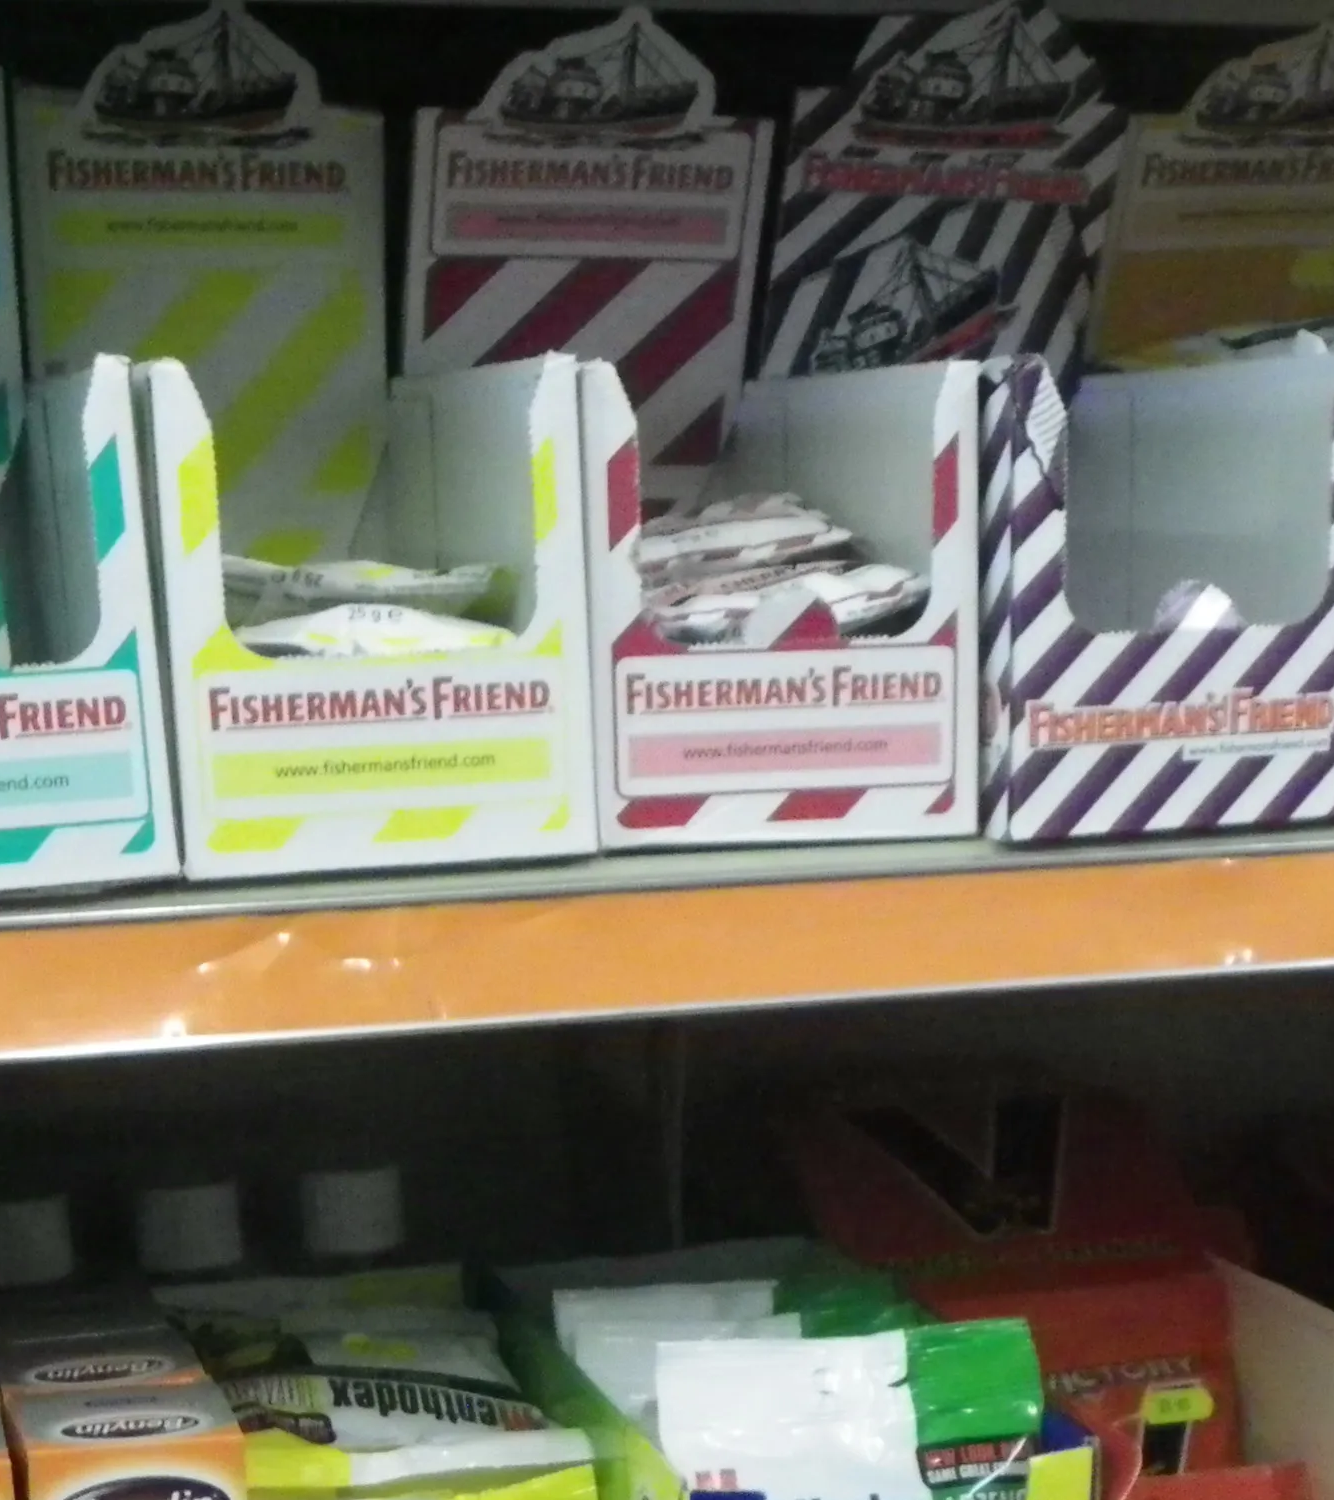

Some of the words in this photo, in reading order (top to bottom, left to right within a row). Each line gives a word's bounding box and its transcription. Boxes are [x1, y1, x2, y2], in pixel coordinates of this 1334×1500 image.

[48, 150, 240, 188] FISHERMAN'S
[241, 155, 346, 190] FRIEND
[447, 155, 631, 190] FISHERMAN'S
[633, 154, 733, 190] FRIEND
[208, 679, 426, 731] FISHERMAN'S
[433, 676, 550, 720] FRIEND
[626, 668, 826, 715] FISHERMAN'S
[833, 666, 942, 707] FRIEND
[1028, 694, 1226, 747] FISHERMAN'S
[1227, 687, 1334, 737] FRIEND
[275, 752, 495, 779] www.fishermansfriend.com
[682, 737, 888, 760] www.fishermansfriend.com
